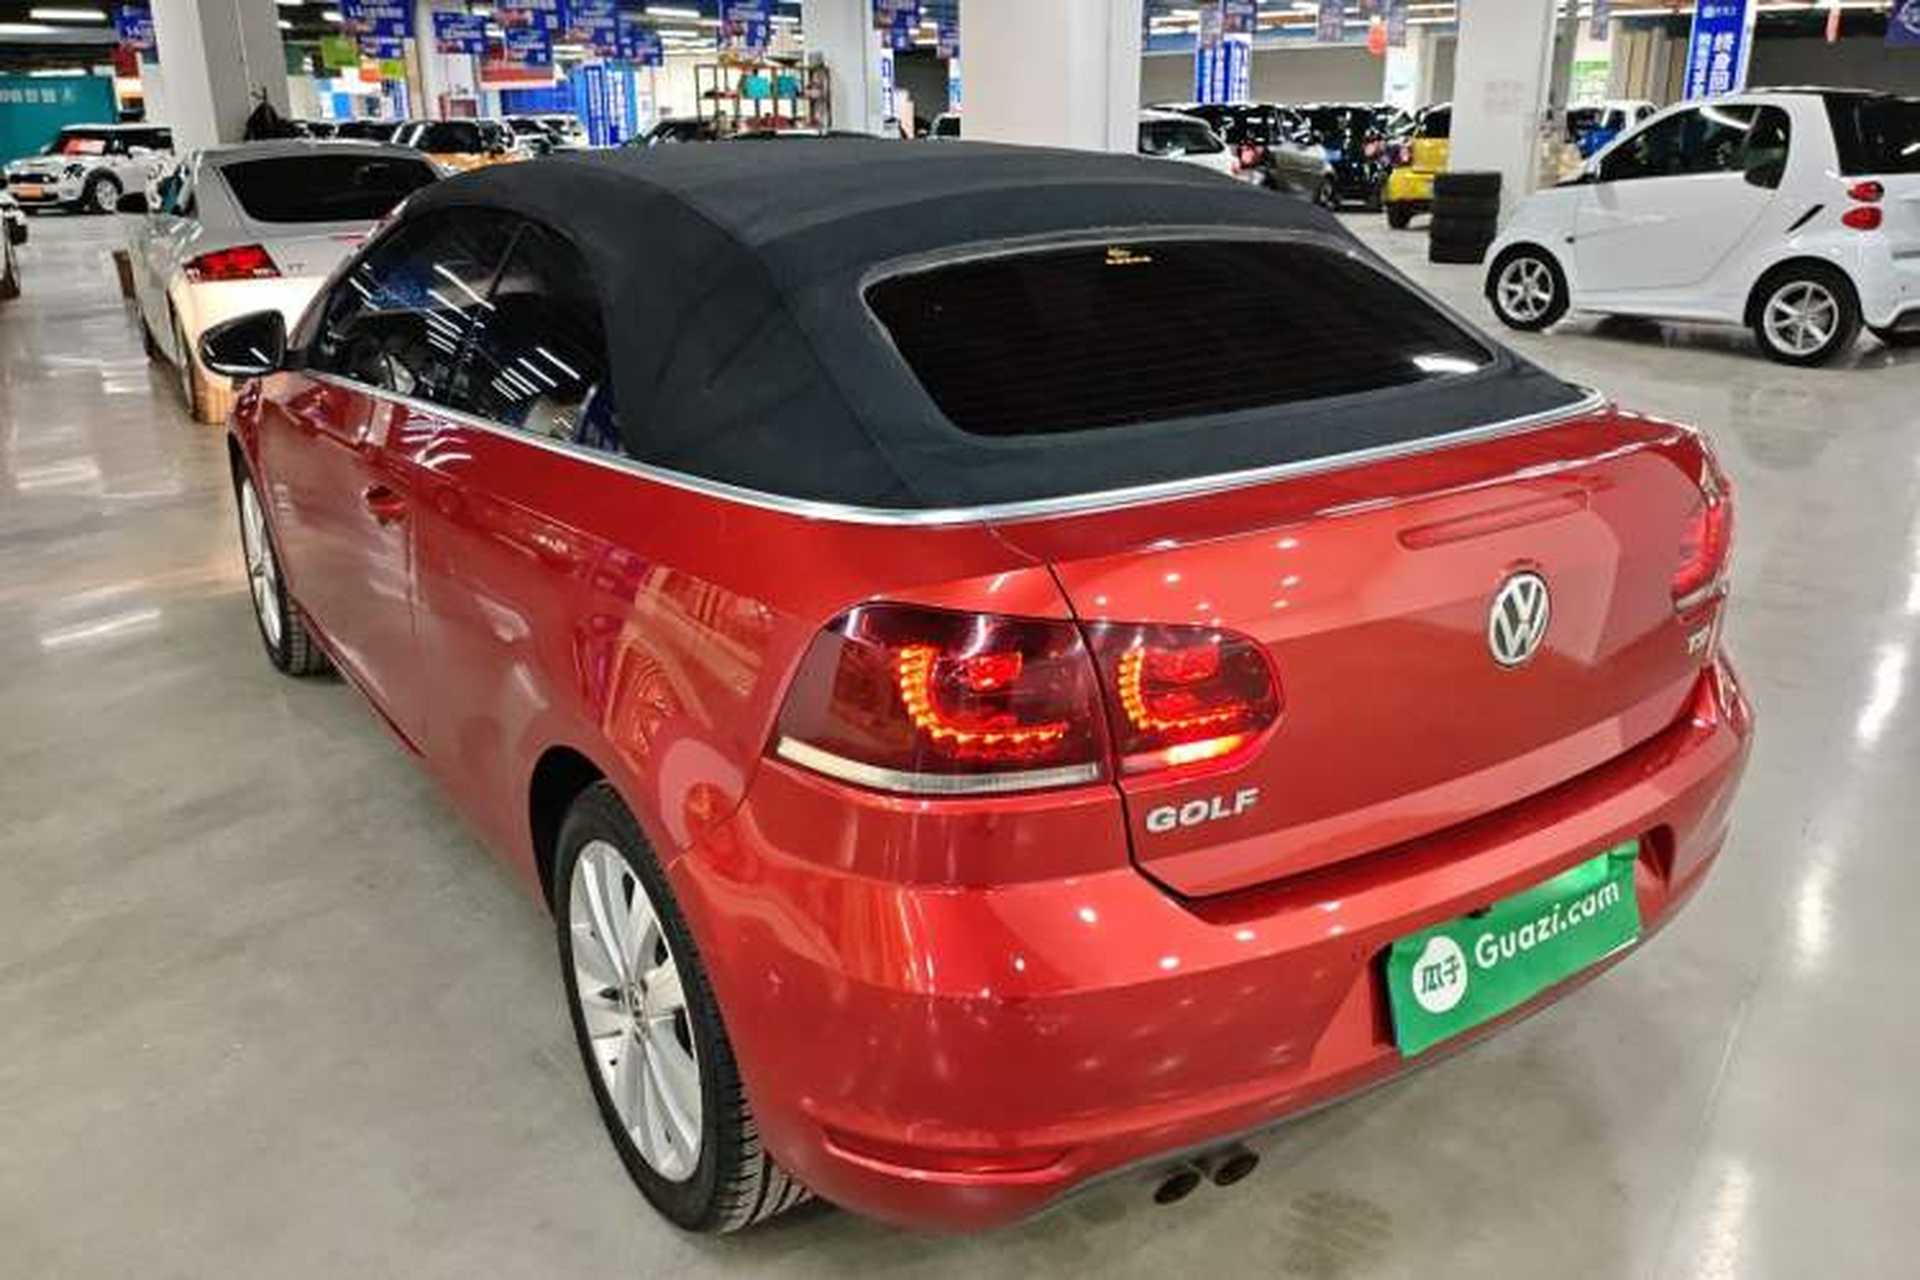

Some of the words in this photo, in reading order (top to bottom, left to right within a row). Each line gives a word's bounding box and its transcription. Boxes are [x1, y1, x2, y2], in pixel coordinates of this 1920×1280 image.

[1146, 788, 1260, 833] GOLF
[1475, 882, 1620, 969] Guazi.com
[1419, 955, 1462, 994] 瓜子
